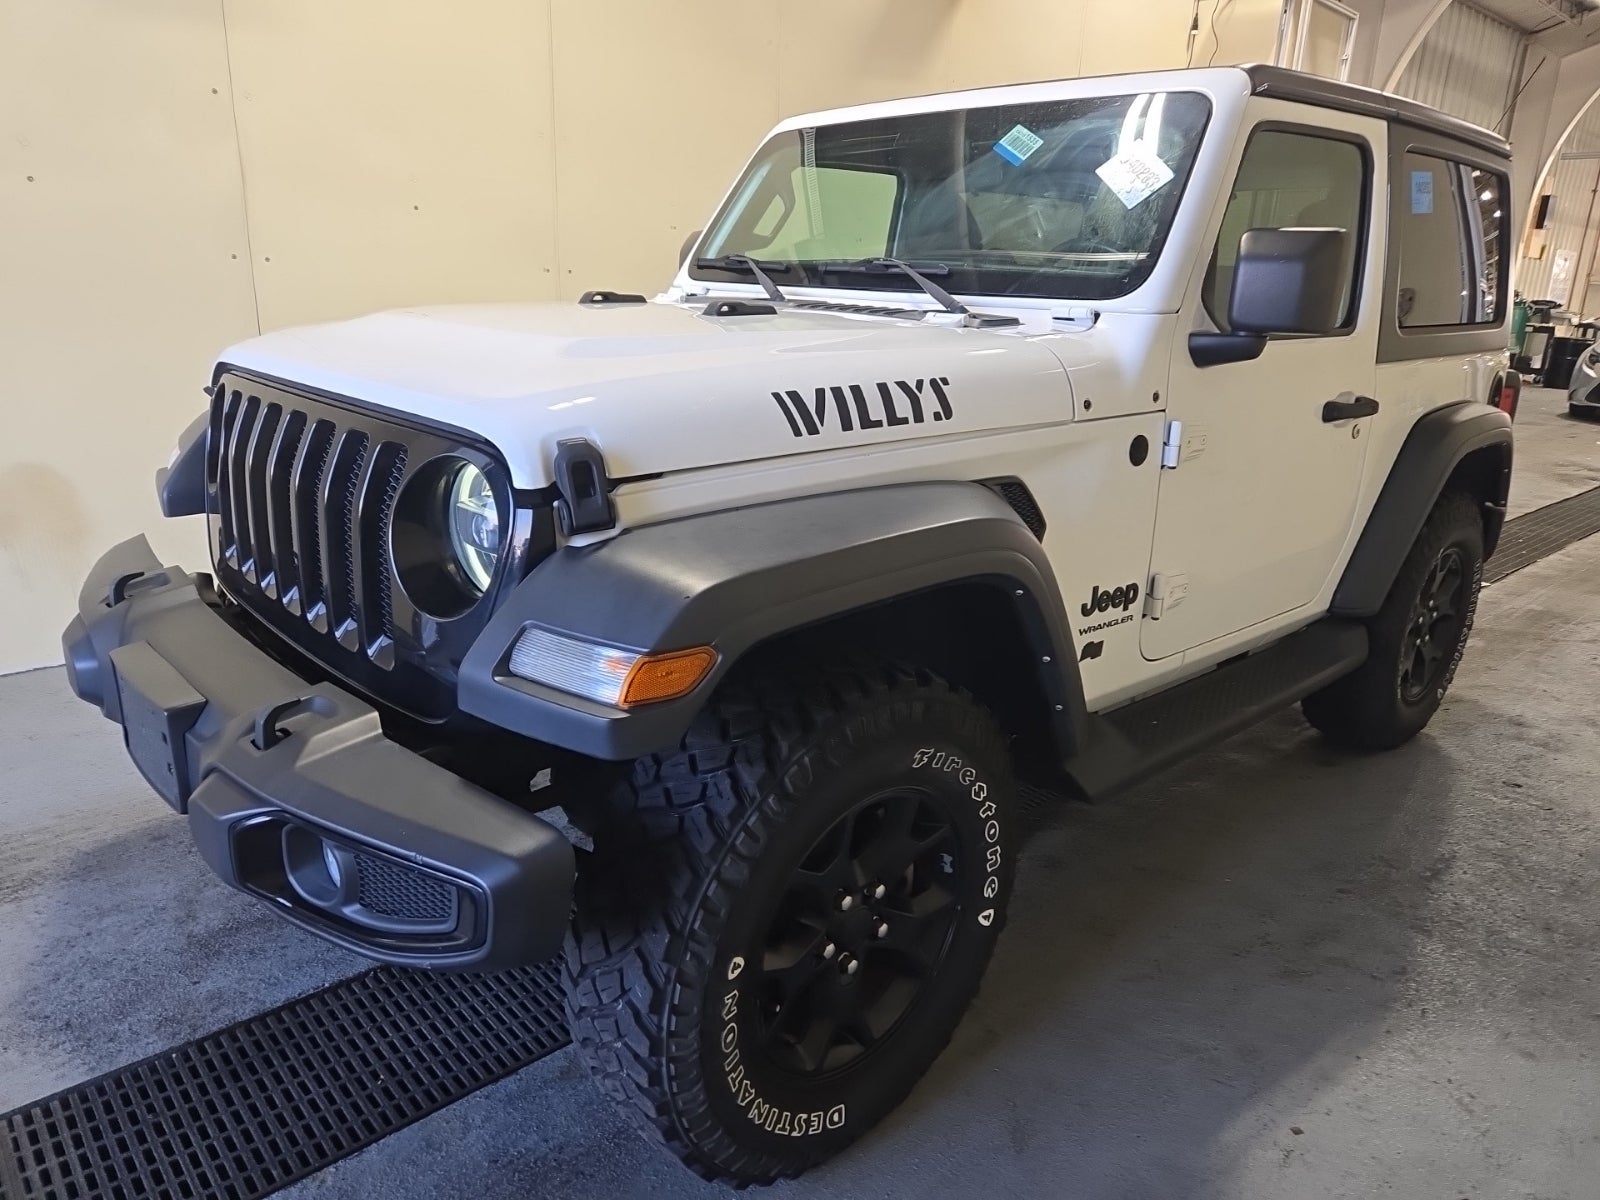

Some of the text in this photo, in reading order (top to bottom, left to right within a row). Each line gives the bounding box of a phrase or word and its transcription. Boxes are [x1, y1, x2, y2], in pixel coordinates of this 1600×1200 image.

[771, 376, 953, 438] WILLYS
[1078, 614, 1134, 636] WRANGLER
[1080, 582, 1139, 617] Jeep
[912, 748, 1001, 898] Firestone
[721, 989, 846, 1137] DESTINATION
